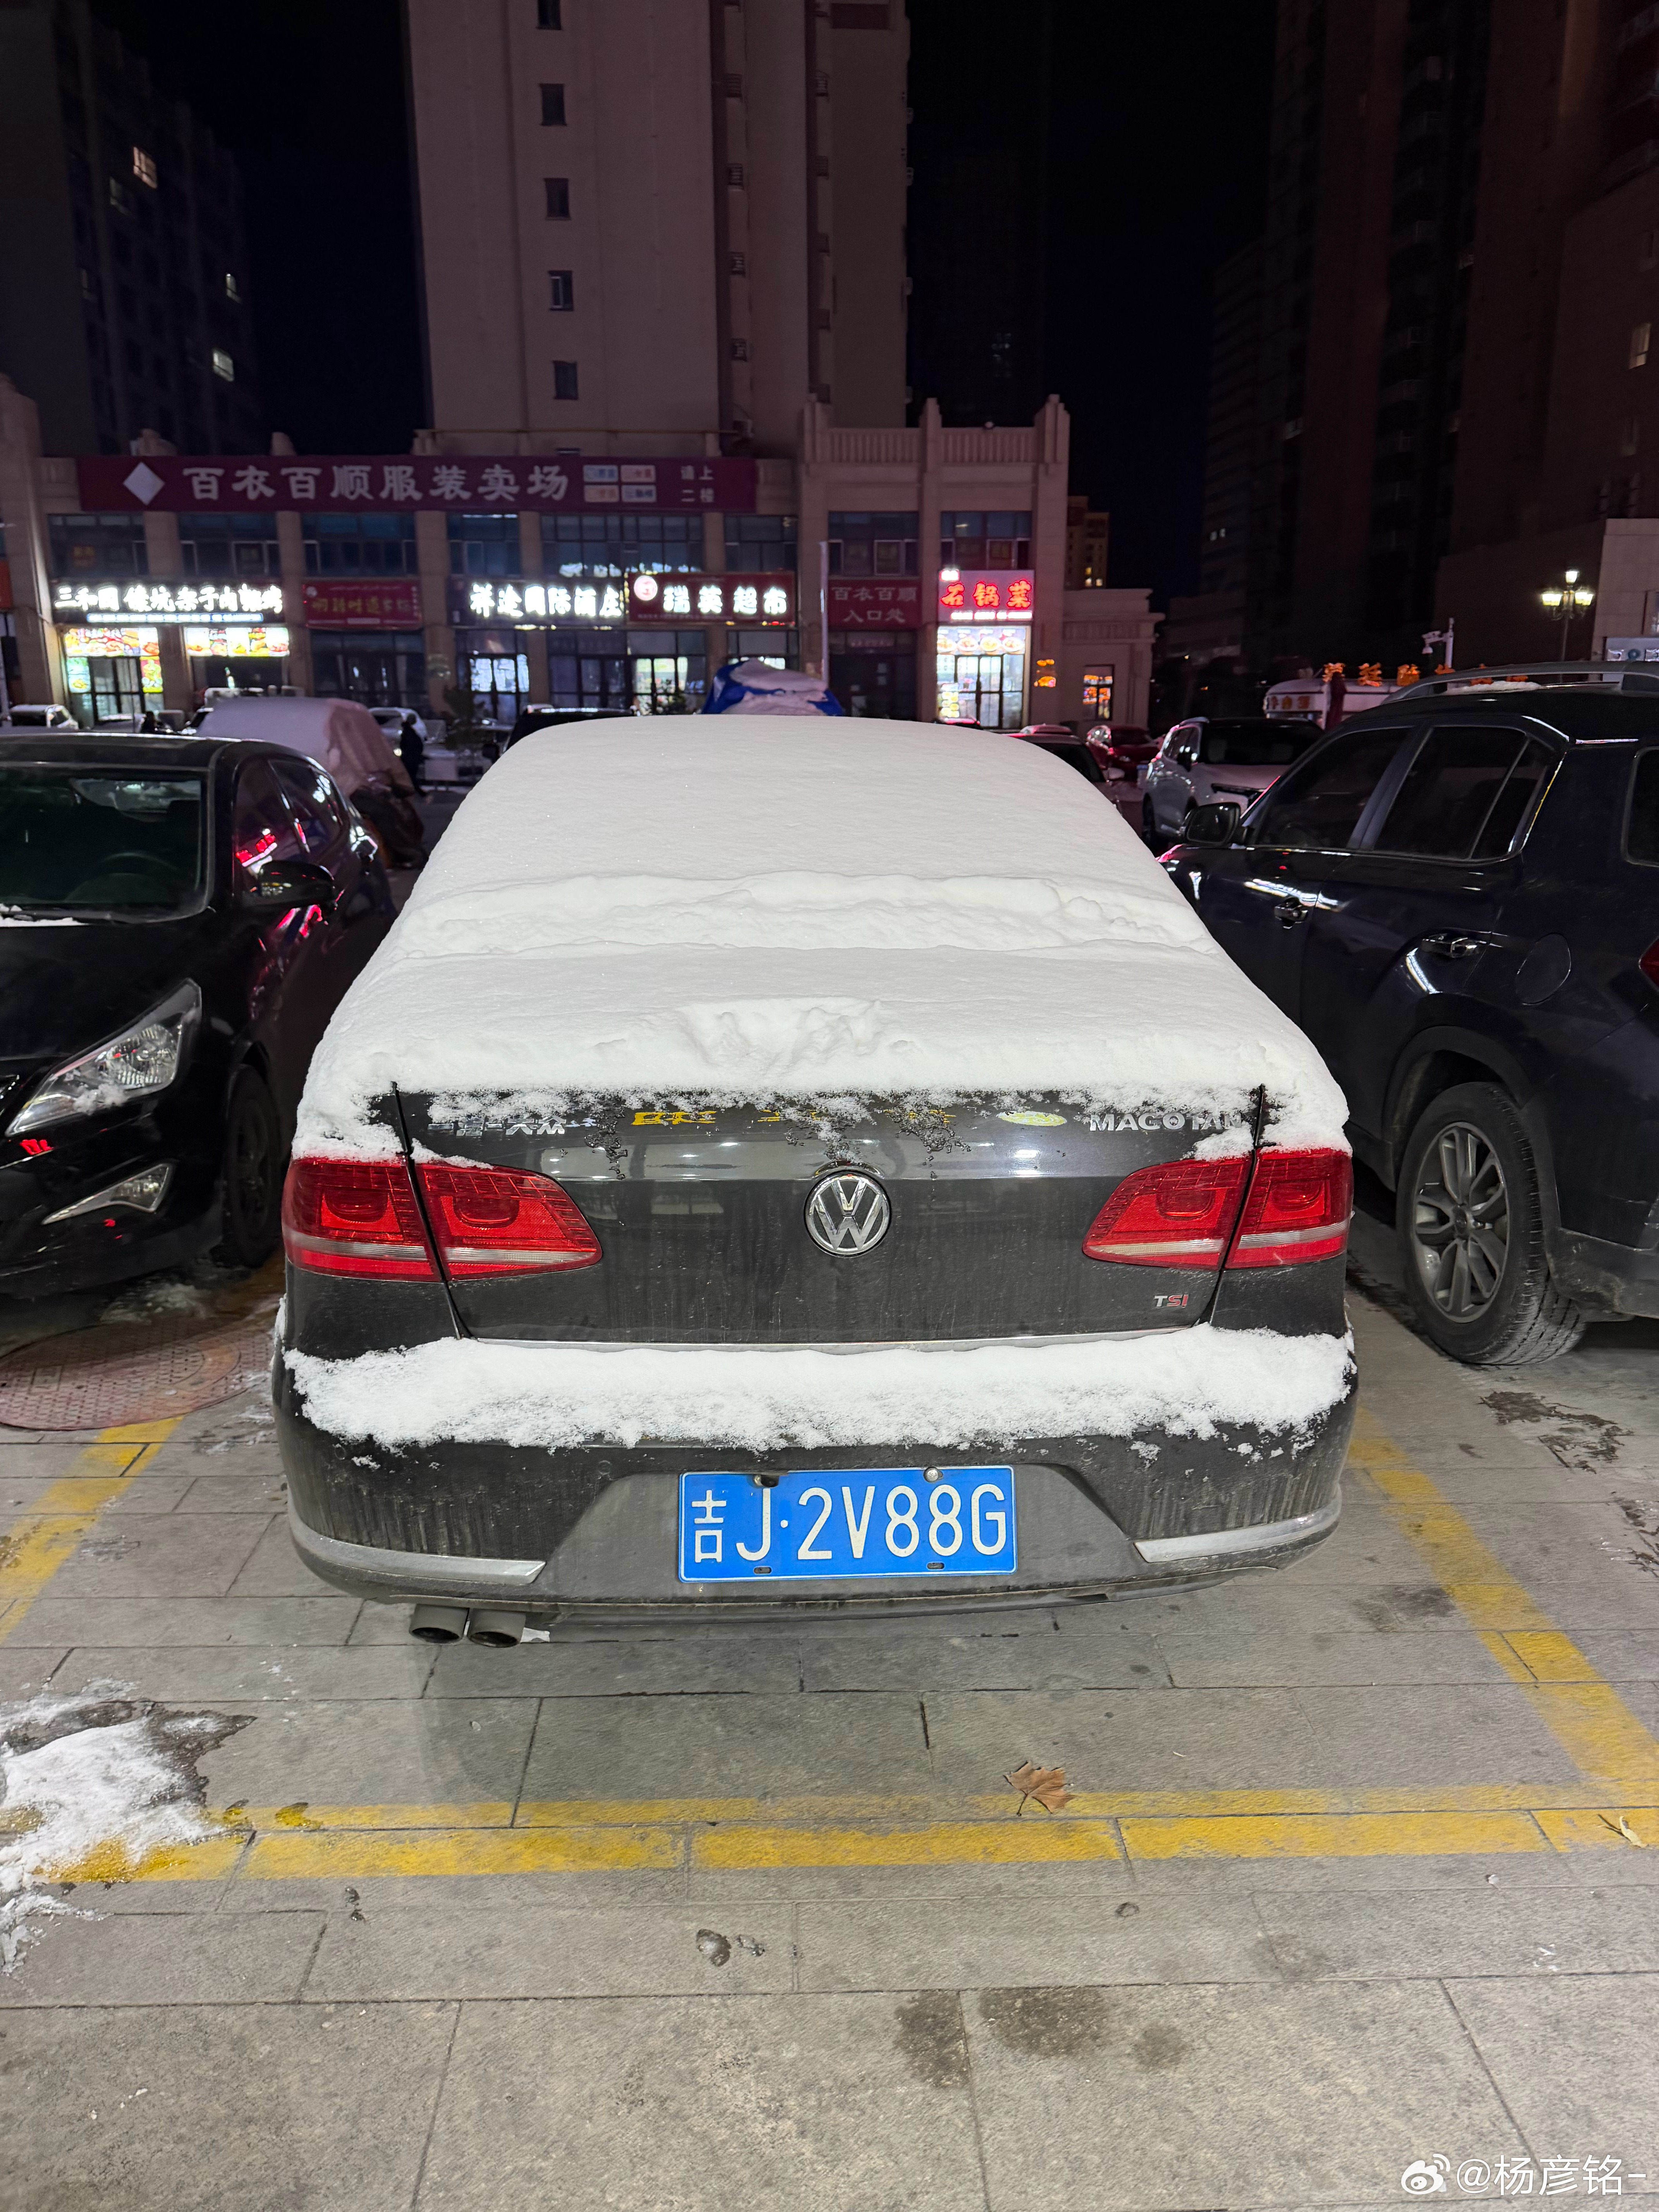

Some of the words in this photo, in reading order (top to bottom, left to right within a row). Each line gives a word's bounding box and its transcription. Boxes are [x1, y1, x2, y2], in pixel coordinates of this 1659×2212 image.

[183, 464, 568, 502] 百衣百顺服装卖场
[663, 585, 787, 614] 瑞英超市
[831, 587, 917, 601] 百衣百顺
[940, 579, 1032, 609] 石锅菜
[842, 608, 906, 623] 入口处
[1154, 1293, 1188, 1309] TSI
